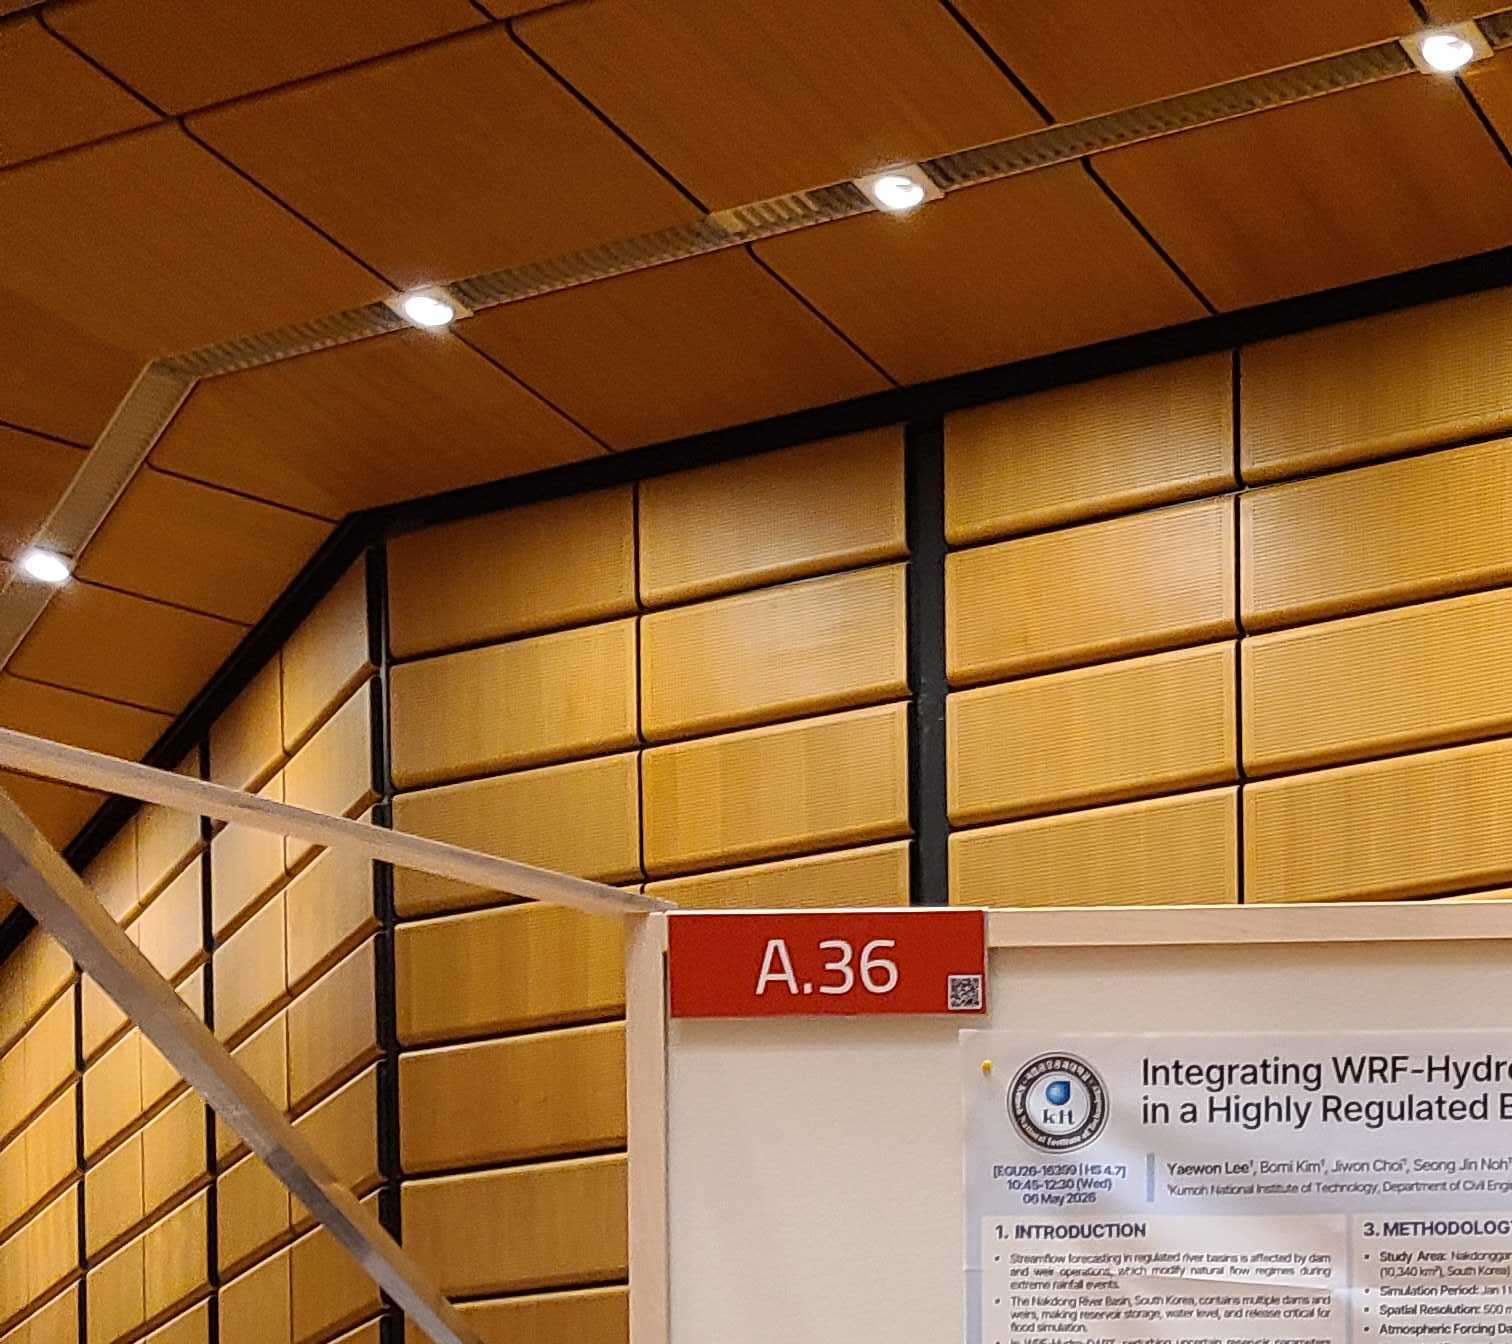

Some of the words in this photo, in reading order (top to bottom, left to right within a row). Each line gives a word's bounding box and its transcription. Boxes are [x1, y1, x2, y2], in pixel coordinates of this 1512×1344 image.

[755, 939, 899, 995] A.36
[1143, 1056, 1321, 1092] Integrating
[1143, 1099, 1169, 1124] in
[1179, 1103, 1198, 1123] a
[1208, 1095, 1310, 1129] Highly
[1321, 1093, 1488, 1128] Regulated
[1414, 1159, 1455, 1173] Seong
[1040, 1194, 1064, 1206] May
[995, 1225, 1009, 1239] 1.
[1015, 1223, 1146, 1239] INTRODUCTION
[1364, 1222, 1380, 1236] 3.
[1380, 1324, 1450, 1336] Atmospheric
[1453, 1323, 1495, 1335] Forcing
